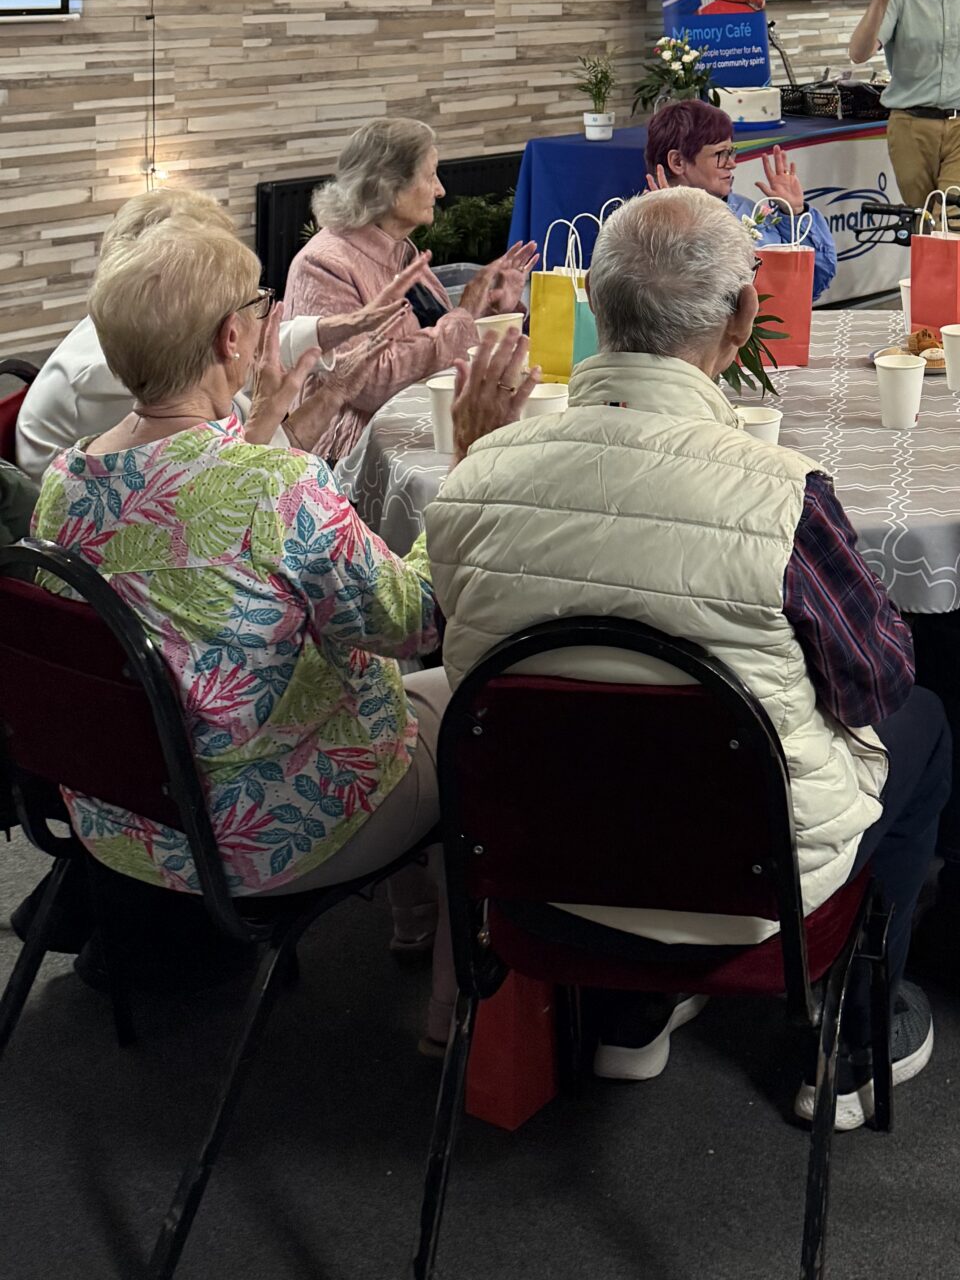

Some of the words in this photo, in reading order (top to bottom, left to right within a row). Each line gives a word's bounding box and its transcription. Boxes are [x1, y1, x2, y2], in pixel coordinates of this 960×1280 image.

[672, 26, 723, 42] Memory
[725, 22, 752, 39] Café
[717, 57, 749, 69] community
